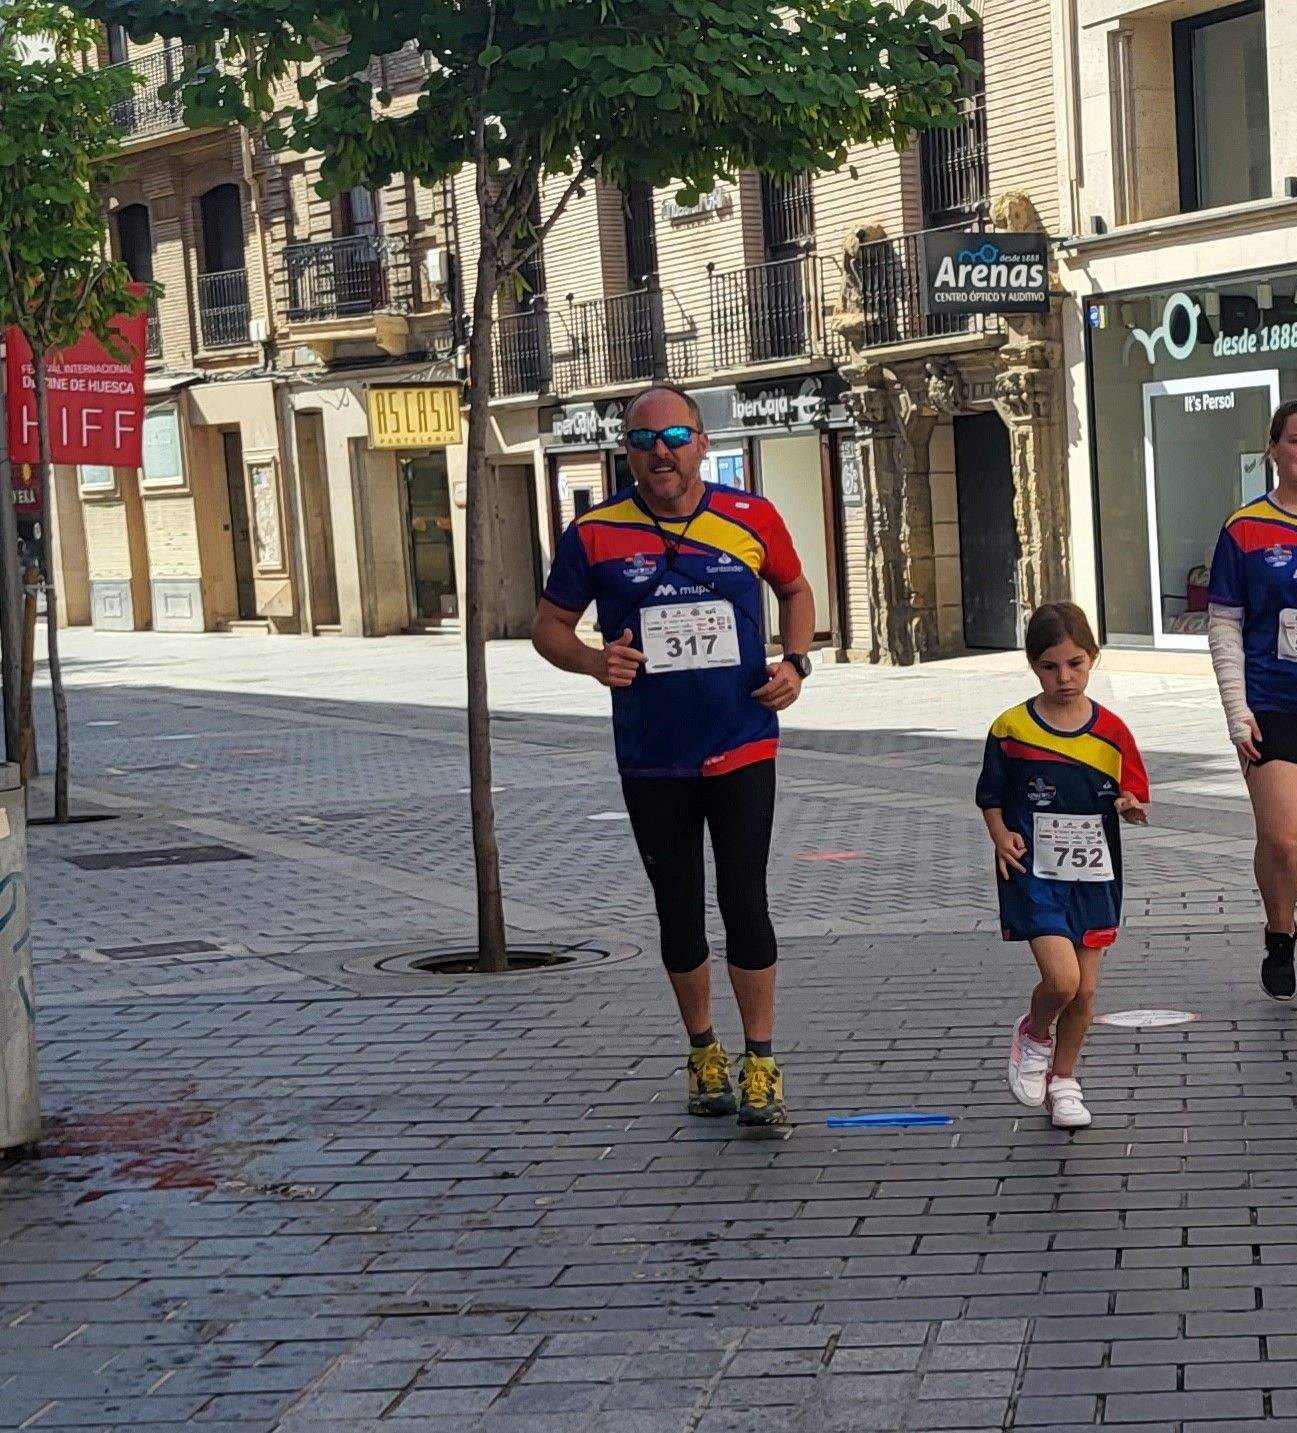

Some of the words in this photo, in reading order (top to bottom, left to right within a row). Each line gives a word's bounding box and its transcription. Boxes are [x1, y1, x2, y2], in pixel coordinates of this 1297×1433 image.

[934, 256, 1044, 288] Arenas
[934, 292, 967, 302] CENTRO
[969, 290, 999, 302] ÓPTICO
[1000, 292, 1007, 302] Y
[1008, 292, 1045, 302] AUDITIVO
[1213, 328, 1256, 357] desde
[70, 378, 86, 391] DE
[88, 379, 135, 395] HUESCA
[375, 390, 455, 434] ASCASO
[1184, 396, 1201, 412] It's
[1203, 392, 1235, 410] Persol
[22, 404, 136, 449] HIFF
[665, 634, 718, 658] 317
[1053, 847, 1104, 868] 752
